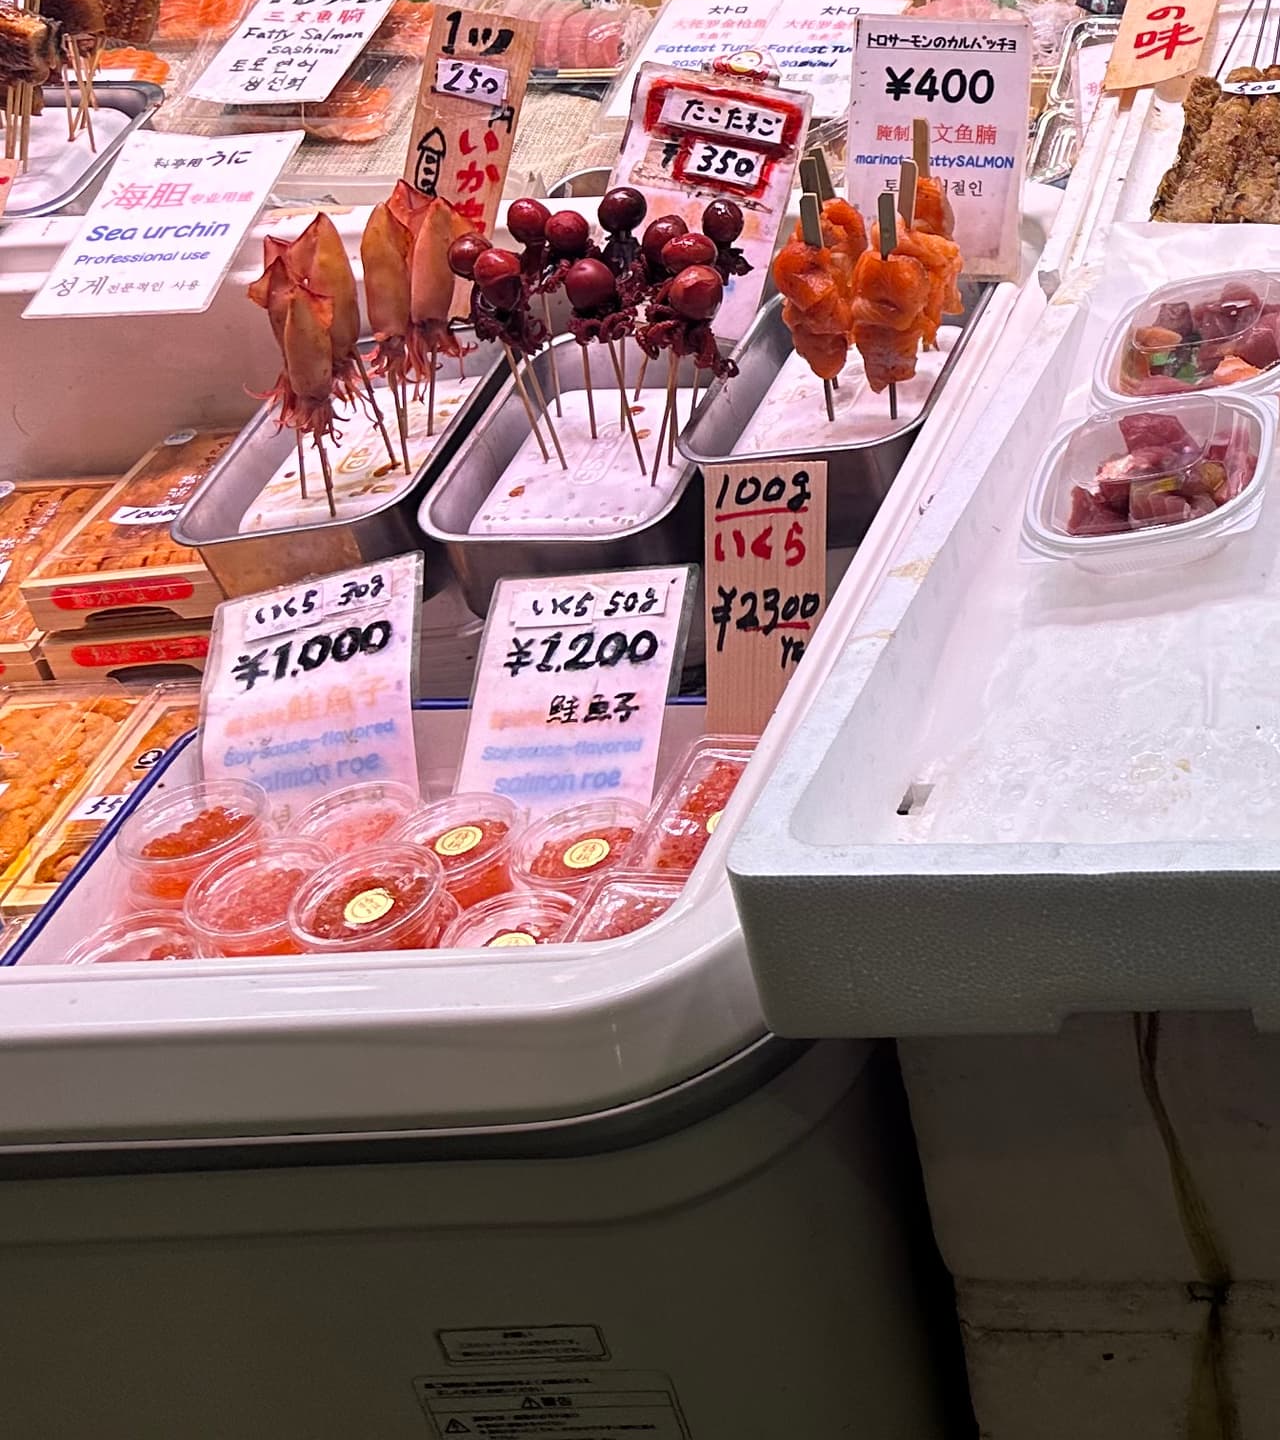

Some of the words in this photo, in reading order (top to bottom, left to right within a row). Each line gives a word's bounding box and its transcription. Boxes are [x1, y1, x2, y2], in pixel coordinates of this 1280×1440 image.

[241, 25, 291, 41] Fatty
[866, 33, 1017, 51] トロサーモンのカルパッチョ
[442, 64, 499, 93] 250
[884, 67, 995, 105] ¥400
[85, 223, 138, 242] Sea
[143, 219, 230, 240] urchin
[74, 252, 178, 266] Professional
